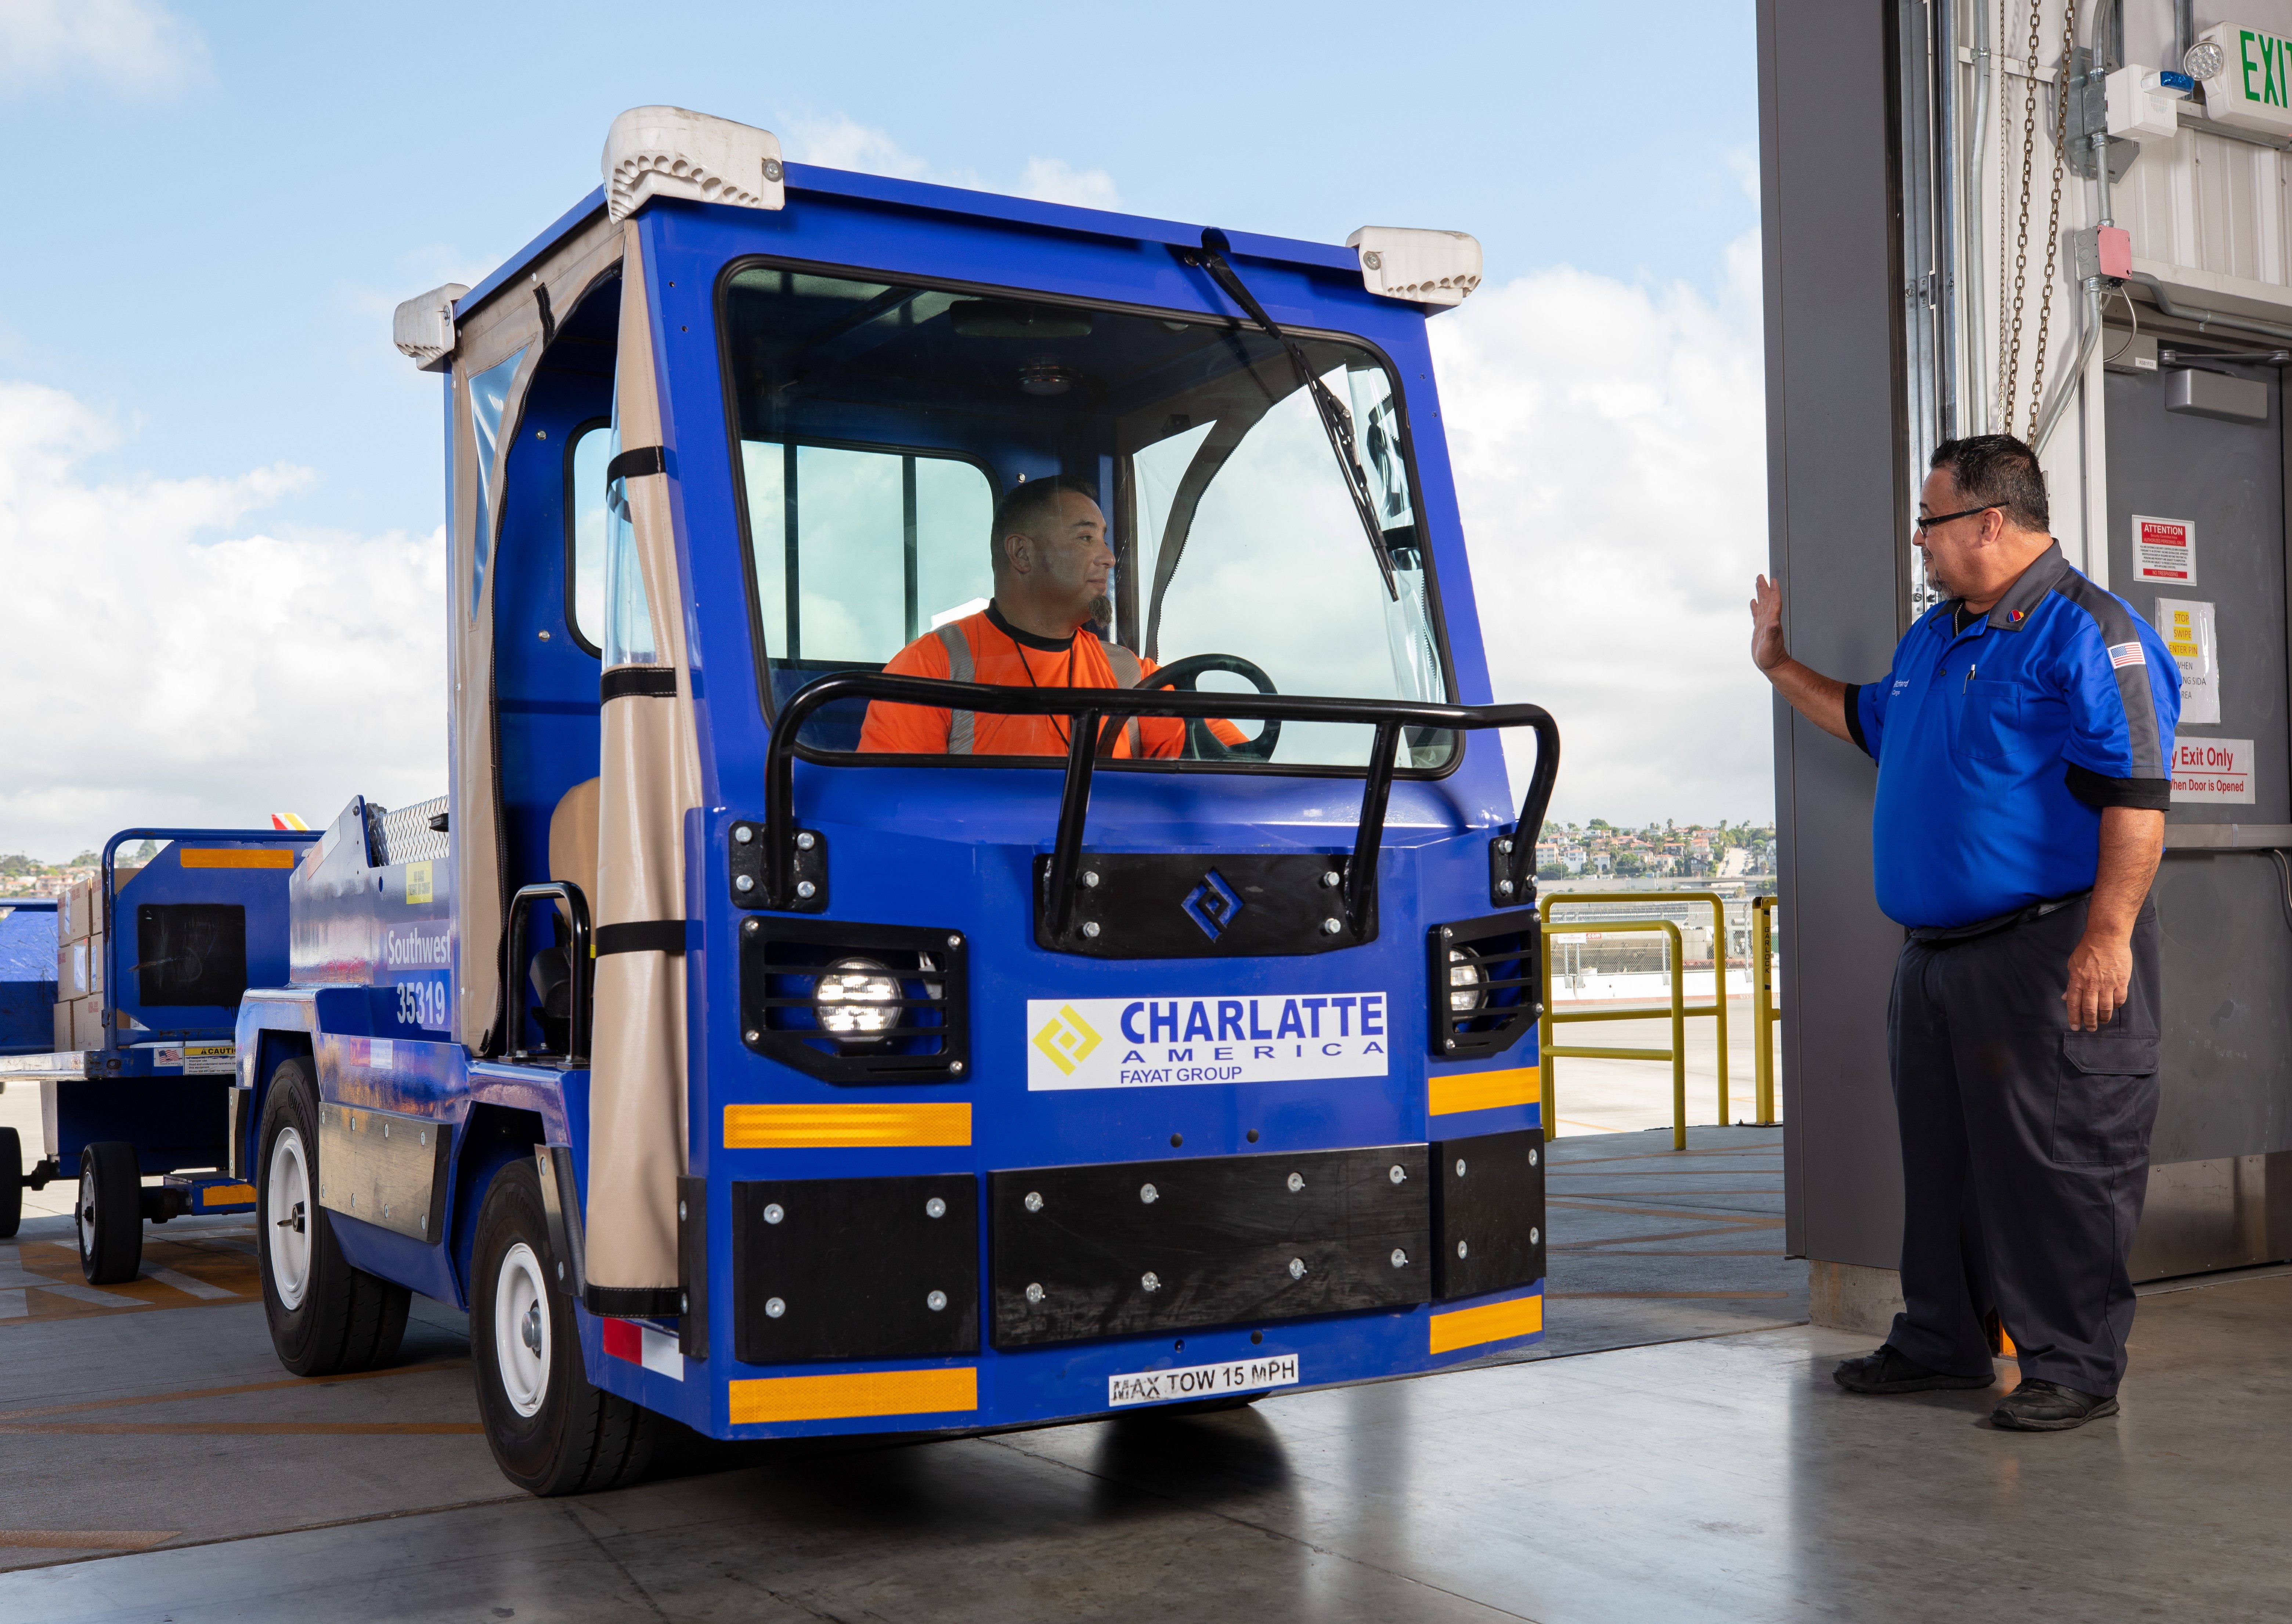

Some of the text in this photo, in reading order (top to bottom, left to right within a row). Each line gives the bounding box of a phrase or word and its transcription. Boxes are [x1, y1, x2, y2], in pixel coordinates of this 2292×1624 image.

[2144, 524, 2183, 535] ATTENTION
[2174, 614, 2189, 622] STOP
[2174, 630, 2191, 638] SWIPE
[2169, 645, 2187, 654] ENTER
[2181, 691, 2192, 699] REA
[2181, 746, 2203, 766] Exit
[2207, 747, 2233, 771] Only
[2171, 779, 2244, 794] hen Door is Opened
[388, 927, 450, 965] Southwest
[397, 981, 445, 1024] 35319
[1120, 996, 1384, 1044] CHARLATTE
[1121, 1041, 1385, 1064] AMERICA
[1120, 1066, 1242, 1084] FAYAT GROUP
[1113, 1360, 1294, 1401] MAX TOW 15 MPH
